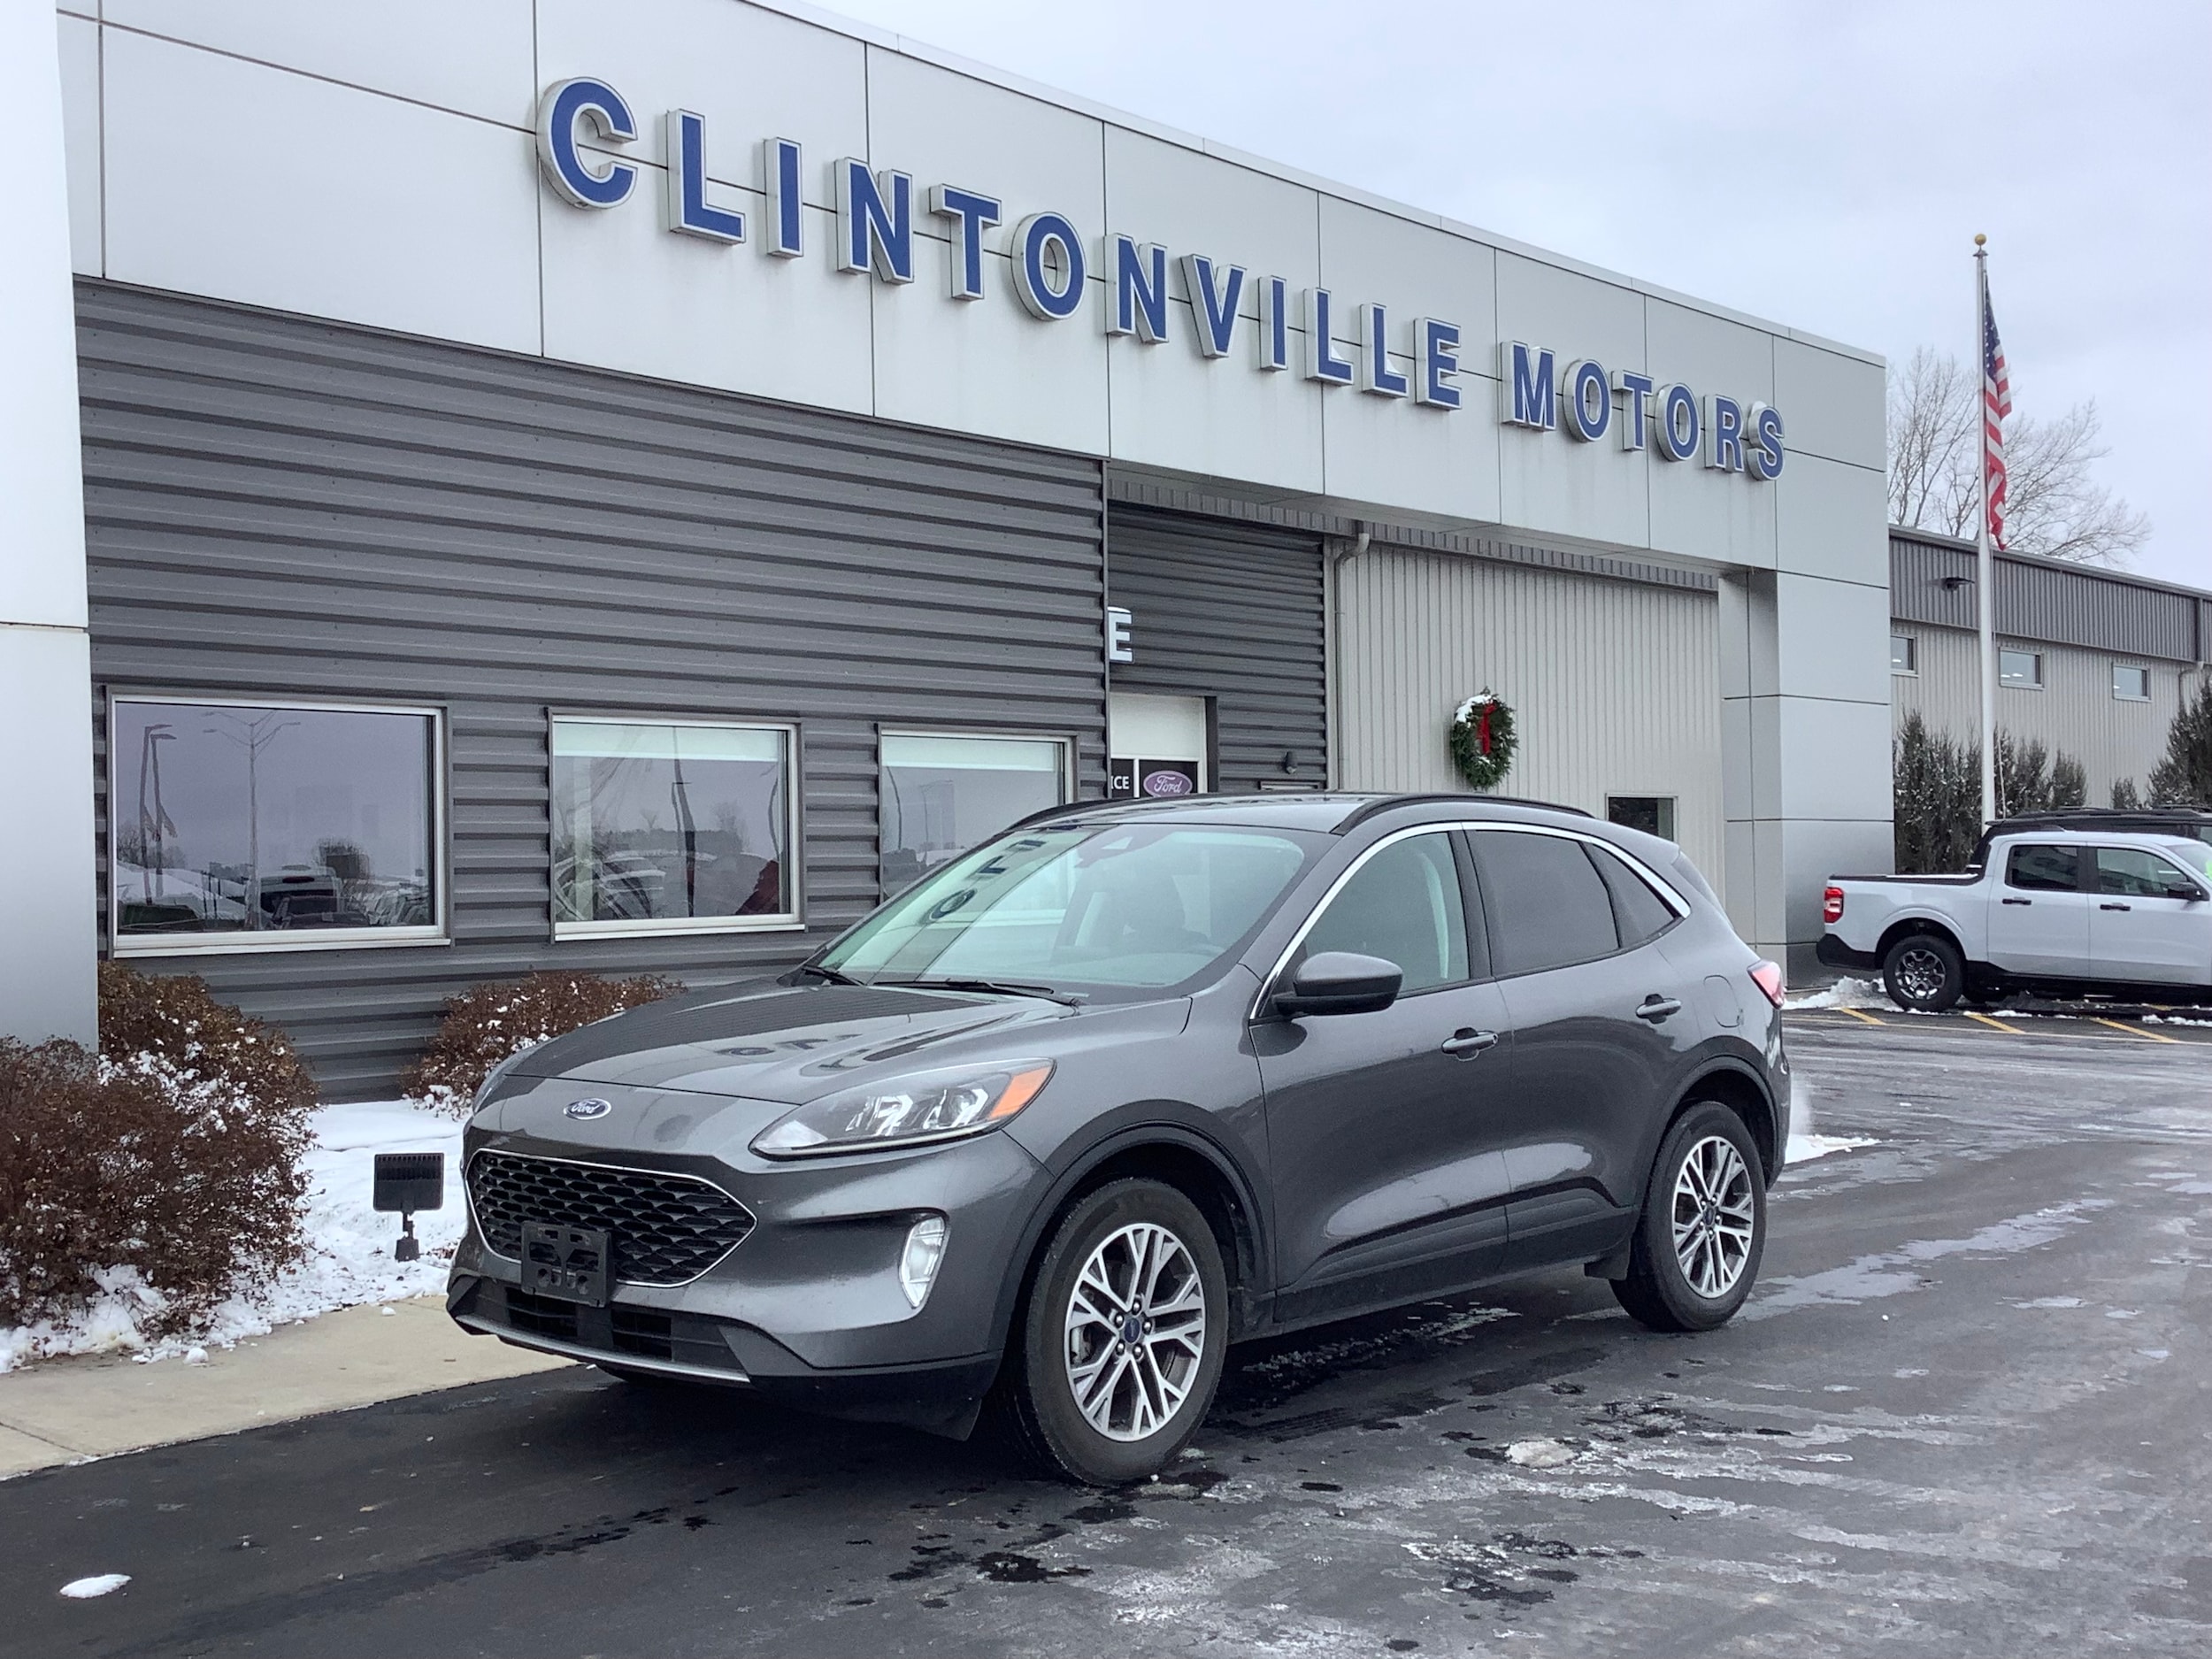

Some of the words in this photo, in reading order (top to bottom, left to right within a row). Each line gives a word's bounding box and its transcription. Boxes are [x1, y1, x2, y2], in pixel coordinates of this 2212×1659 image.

[536, 76, 1462, 411] CLINTONVILLE
[1502, 340, 1785, 481] MOTORS
[1154, 775, 1183, 793] Ford
[571, 1101, 601, 1114] Ford
